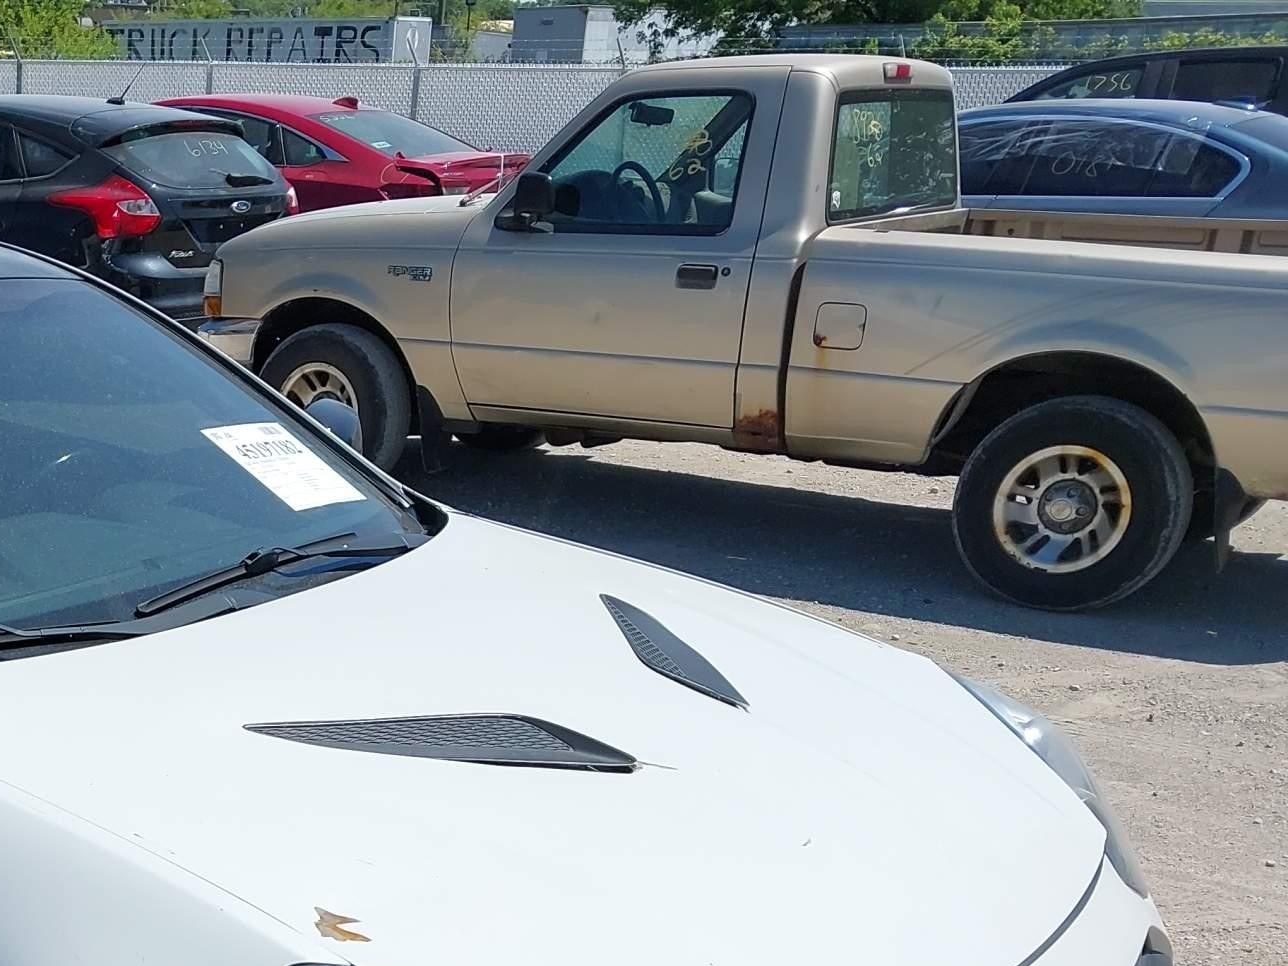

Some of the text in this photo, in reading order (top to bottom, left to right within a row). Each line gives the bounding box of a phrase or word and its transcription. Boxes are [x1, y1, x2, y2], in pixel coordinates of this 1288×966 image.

[105, 26, 211, 62] TRUCK
[1086, 73, 1132, 92] 1756
[183, 138, 229, 157] 6134
